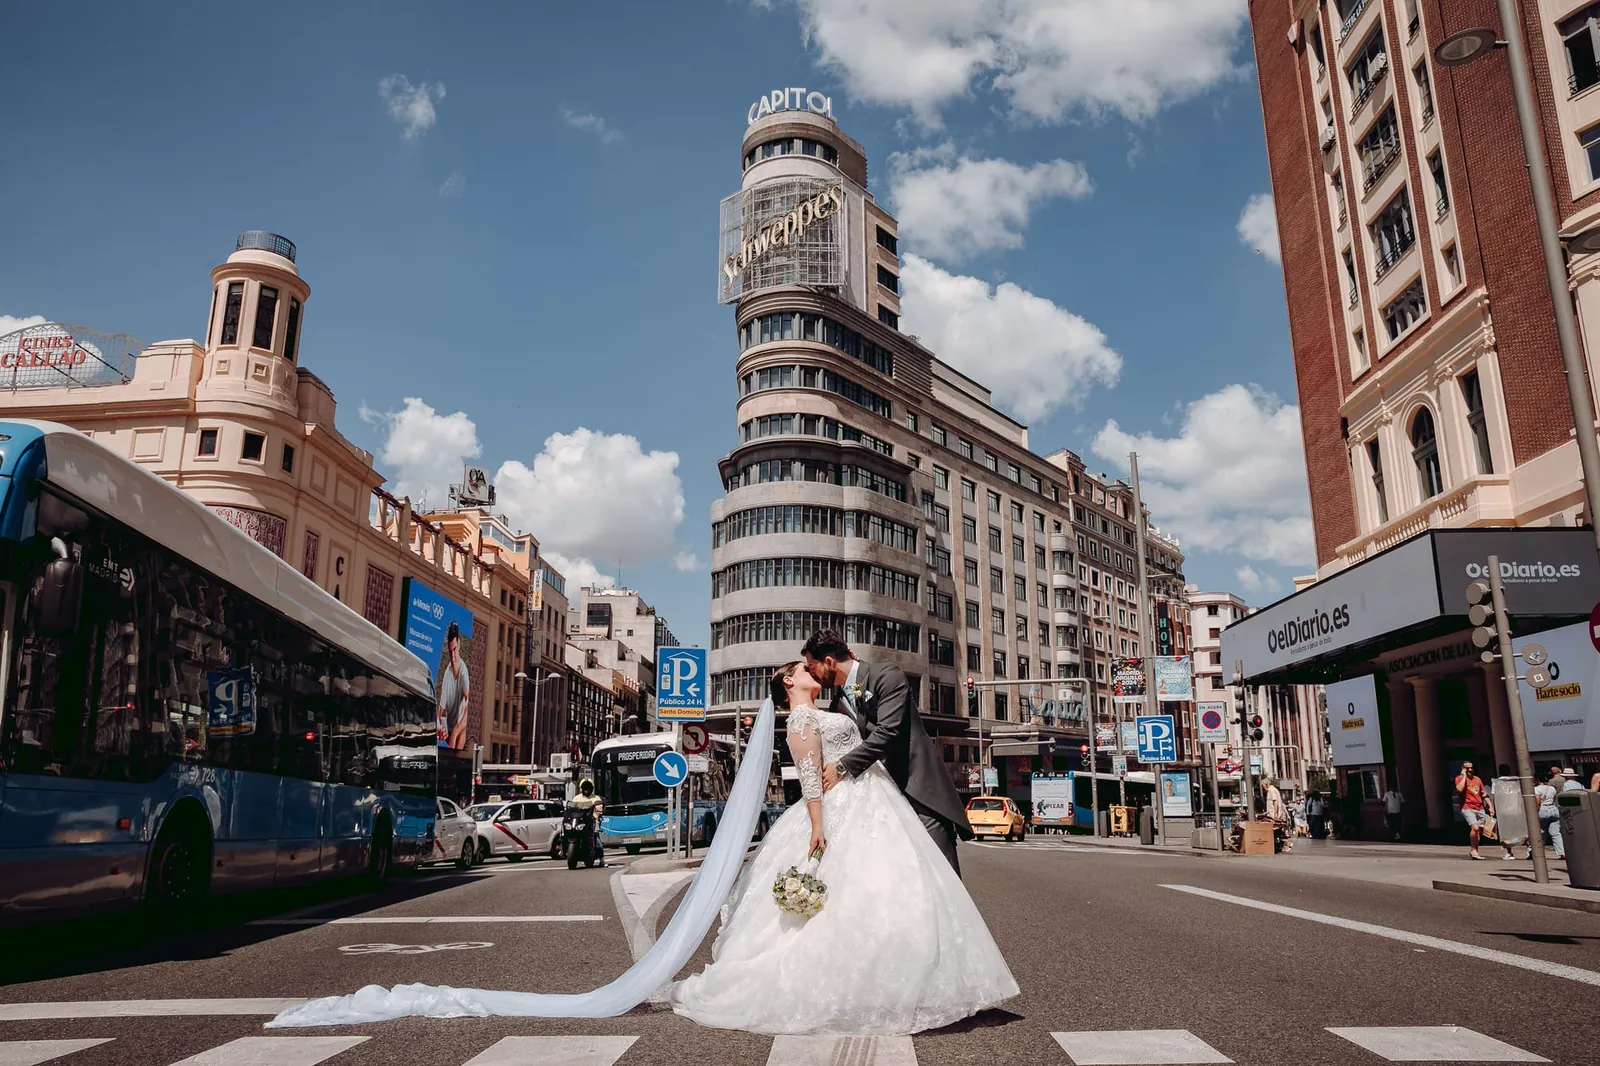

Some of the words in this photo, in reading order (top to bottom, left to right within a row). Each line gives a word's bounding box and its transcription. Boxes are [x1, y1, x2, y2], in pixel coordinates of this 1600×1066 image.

[748, 87, 837, 126] CAPITOL
[723, 184, 841, 293] Schweppes
[20, 336, 73, 350] CINES
[0, 350, 87, 368] CALLAO
[89, 562, 118, 583] MADRID
[103, 558, 119, 572] EMT
[1159, 618, 1168, 655] HOT
[1440, 645, 1455, 660] DE
[1456, 642, 1471, 657] LA
[668, 658, 698, 697] P
[1535, 687, 1560, 700] Hazte
[1560, 683, 1581, 697] socio
[677, 708, 705, 716] Domingo
[1142, 722, 1170, 752] P
[606, 753, 612, 763] 1
[618, 750, 657, 761] PROSPERIDAD
[202, 767, 216, 782] 728
